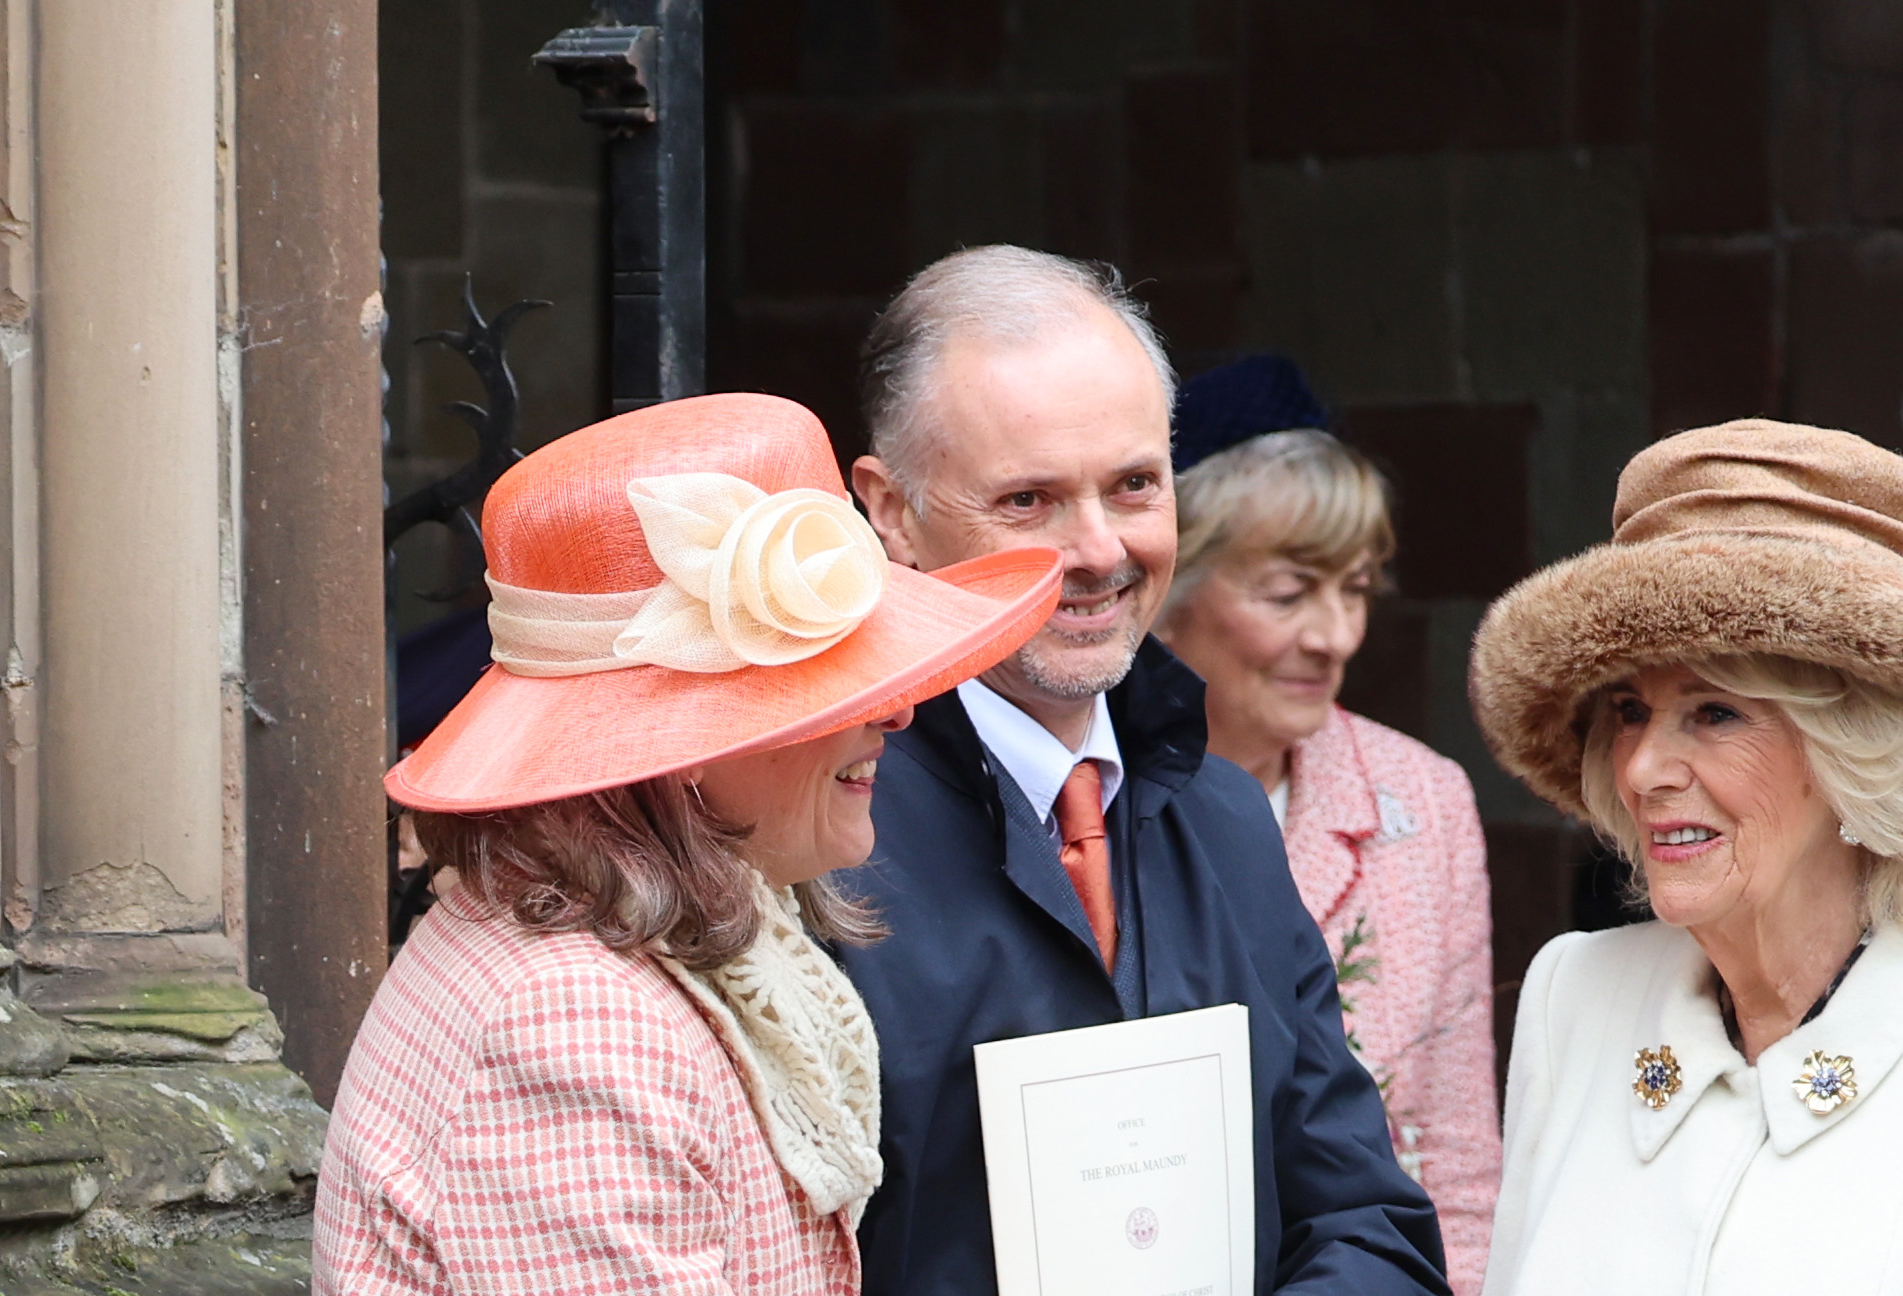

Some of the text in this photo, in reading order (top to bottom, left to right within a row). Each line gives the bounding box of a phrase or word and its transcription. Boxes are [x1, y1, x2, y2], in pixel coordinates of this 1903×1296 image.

[1116, 1117, 1147, 1131] OFFICE
[1079, 1153, 1188, 1182] THE ROYAL MAUNDY
